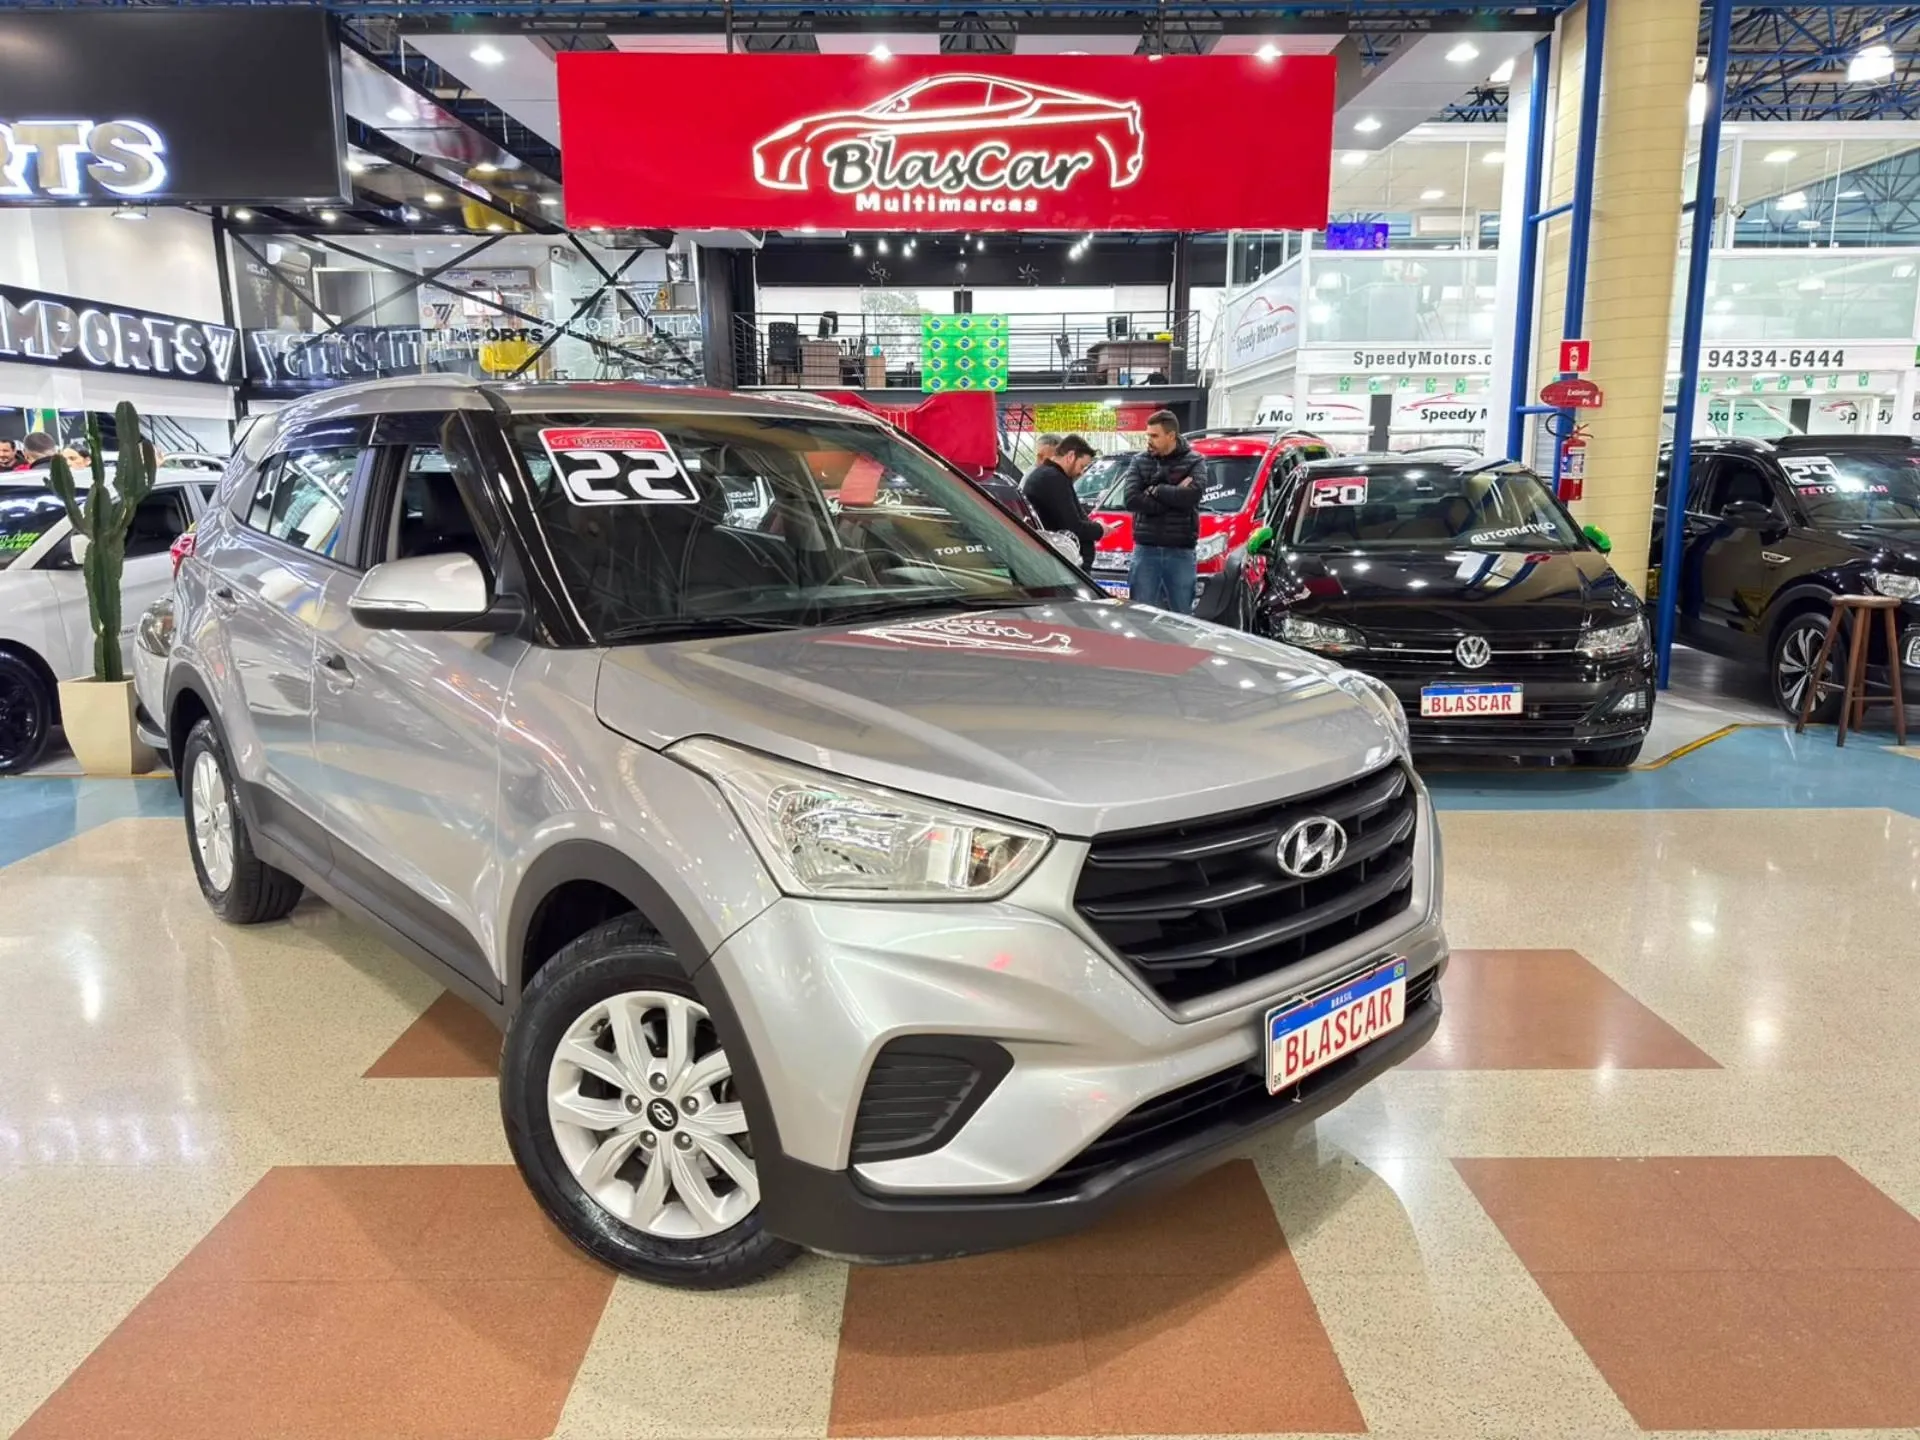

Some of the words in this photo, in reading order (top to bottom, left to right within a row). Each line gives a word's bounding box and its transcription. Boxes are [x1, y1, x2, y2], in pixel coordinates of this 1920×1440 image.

[823, 135, 1094, 194] BlasCar
[855, 192, 1038, 213] Multimarcas
[1708, 350, 1845, 368] 94334-6444
[1421, 408, 1476, 424] Speedy
[564, 451, 687, 500] 22
[1790, 464, 1838, 486] 24
[1314, 485, 1365, 506] 20
[1799, 485, 1836, 495] TETO
[934, 547, 961, 556] TOP
[966, 545, 983, 553] DE
[1431, 694, 1511, 713] BLASCAR
[1285, 987, 1393, 1077] BLASCAR
